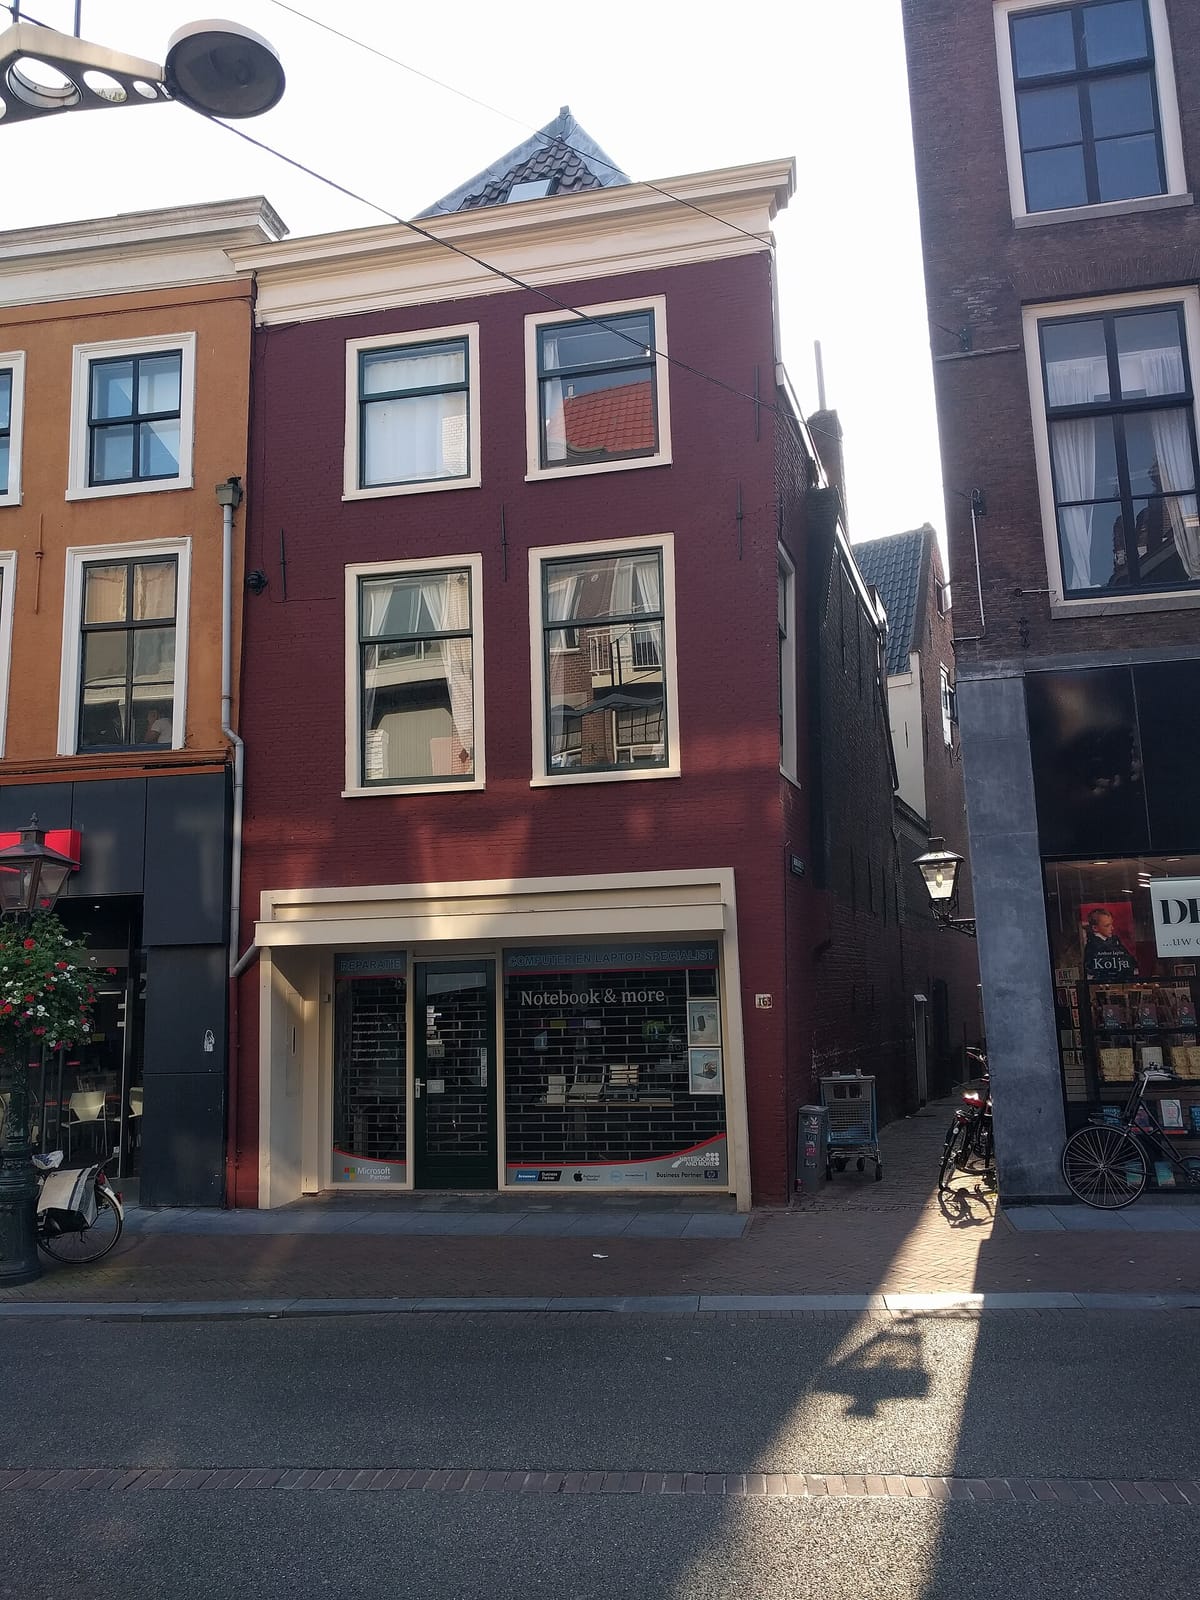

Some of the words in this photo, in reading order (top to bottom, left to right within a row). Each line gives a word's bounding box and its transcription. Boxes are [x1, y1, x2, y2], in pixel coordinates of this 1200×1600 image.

[340, 959, 401, 970] REPARATIE
[512, 954, 573, 967] COMPUTER
[576, 953, 591, 965] EN
[595, 951, 641, 963] LAPTOP
[644, 949, 713, 961] SPECIALIST
[1093, 958, 1130, 971] Kolja
[520, 989, 600, 1006] Notebook
[604, 988, 617, 1003] &
[621, 990, 665, 1003] more
[357, 1167, 391, 1175] Microsoft
